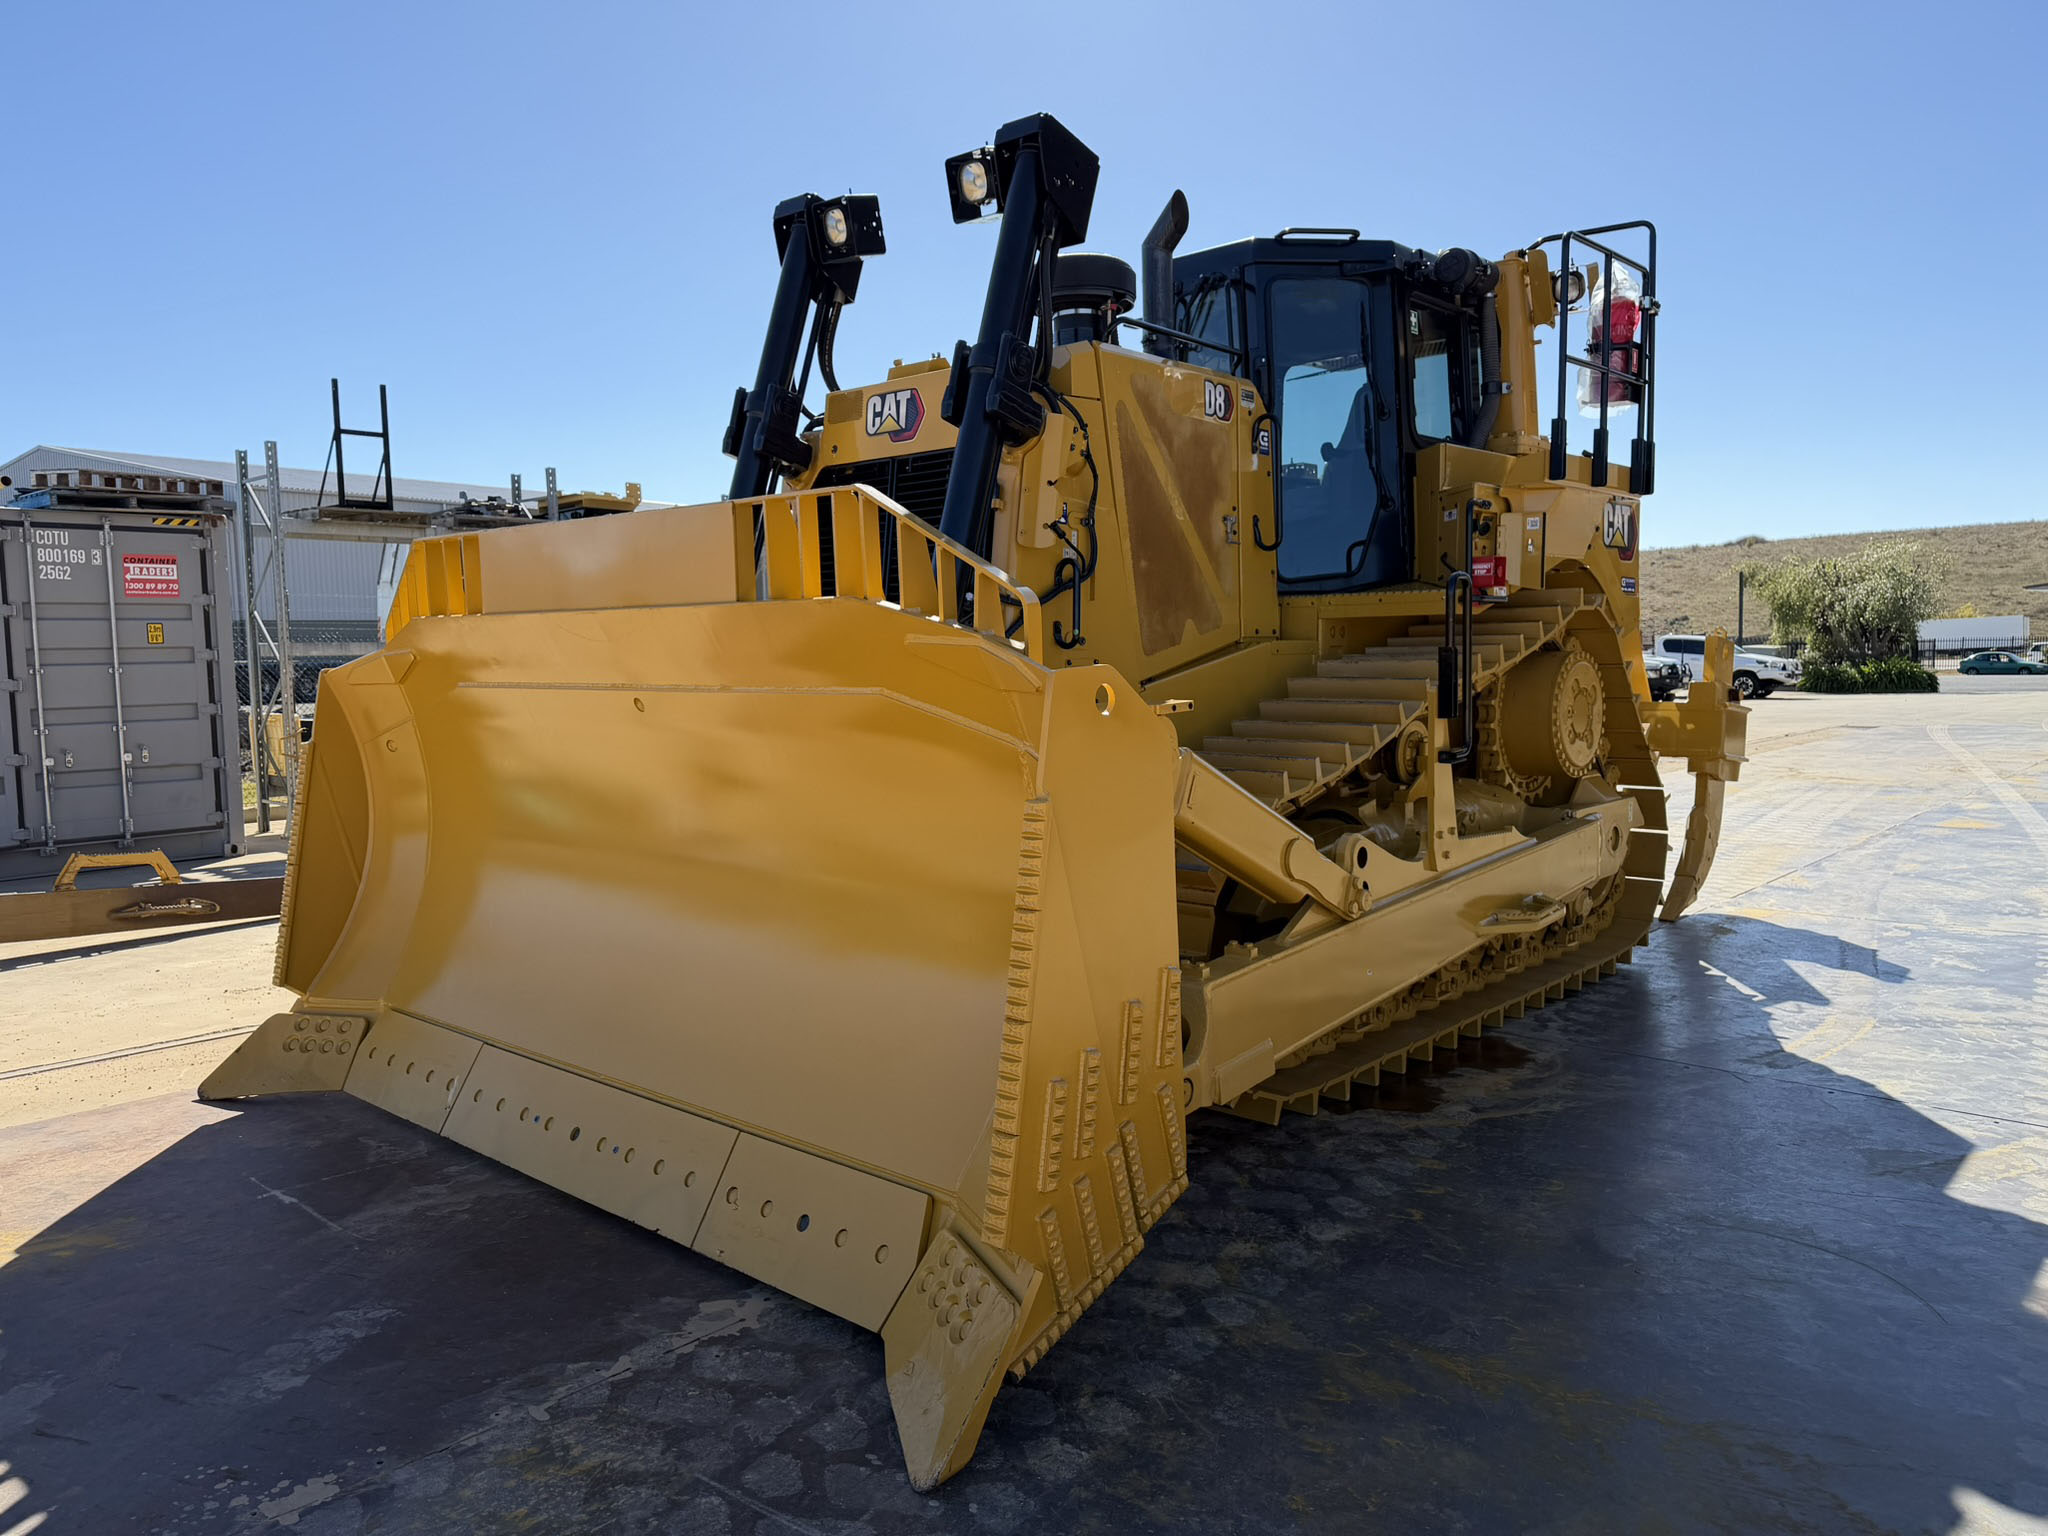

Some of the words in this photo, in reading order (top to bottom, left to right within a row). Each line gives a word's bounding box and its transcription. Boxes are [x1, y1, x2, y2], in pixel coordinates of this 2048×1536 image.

[1205, 380, 1226, 418] D8
[866, 389, 911, 435] CAT
[1603, 502, 1632, 547] CAT
[36, 530, 69, 545] COTU
[37, 548, 86, 564] 800169
[92, 549, 102, 565] 3
[123, 556, 177, 565] CONTAINER
[39, 565, 72, 580] 25G2
[130, 565, 173, 576] TRADERS
[125, 582, 144, 590] 1300
[168, 583, 179, 591] 70
